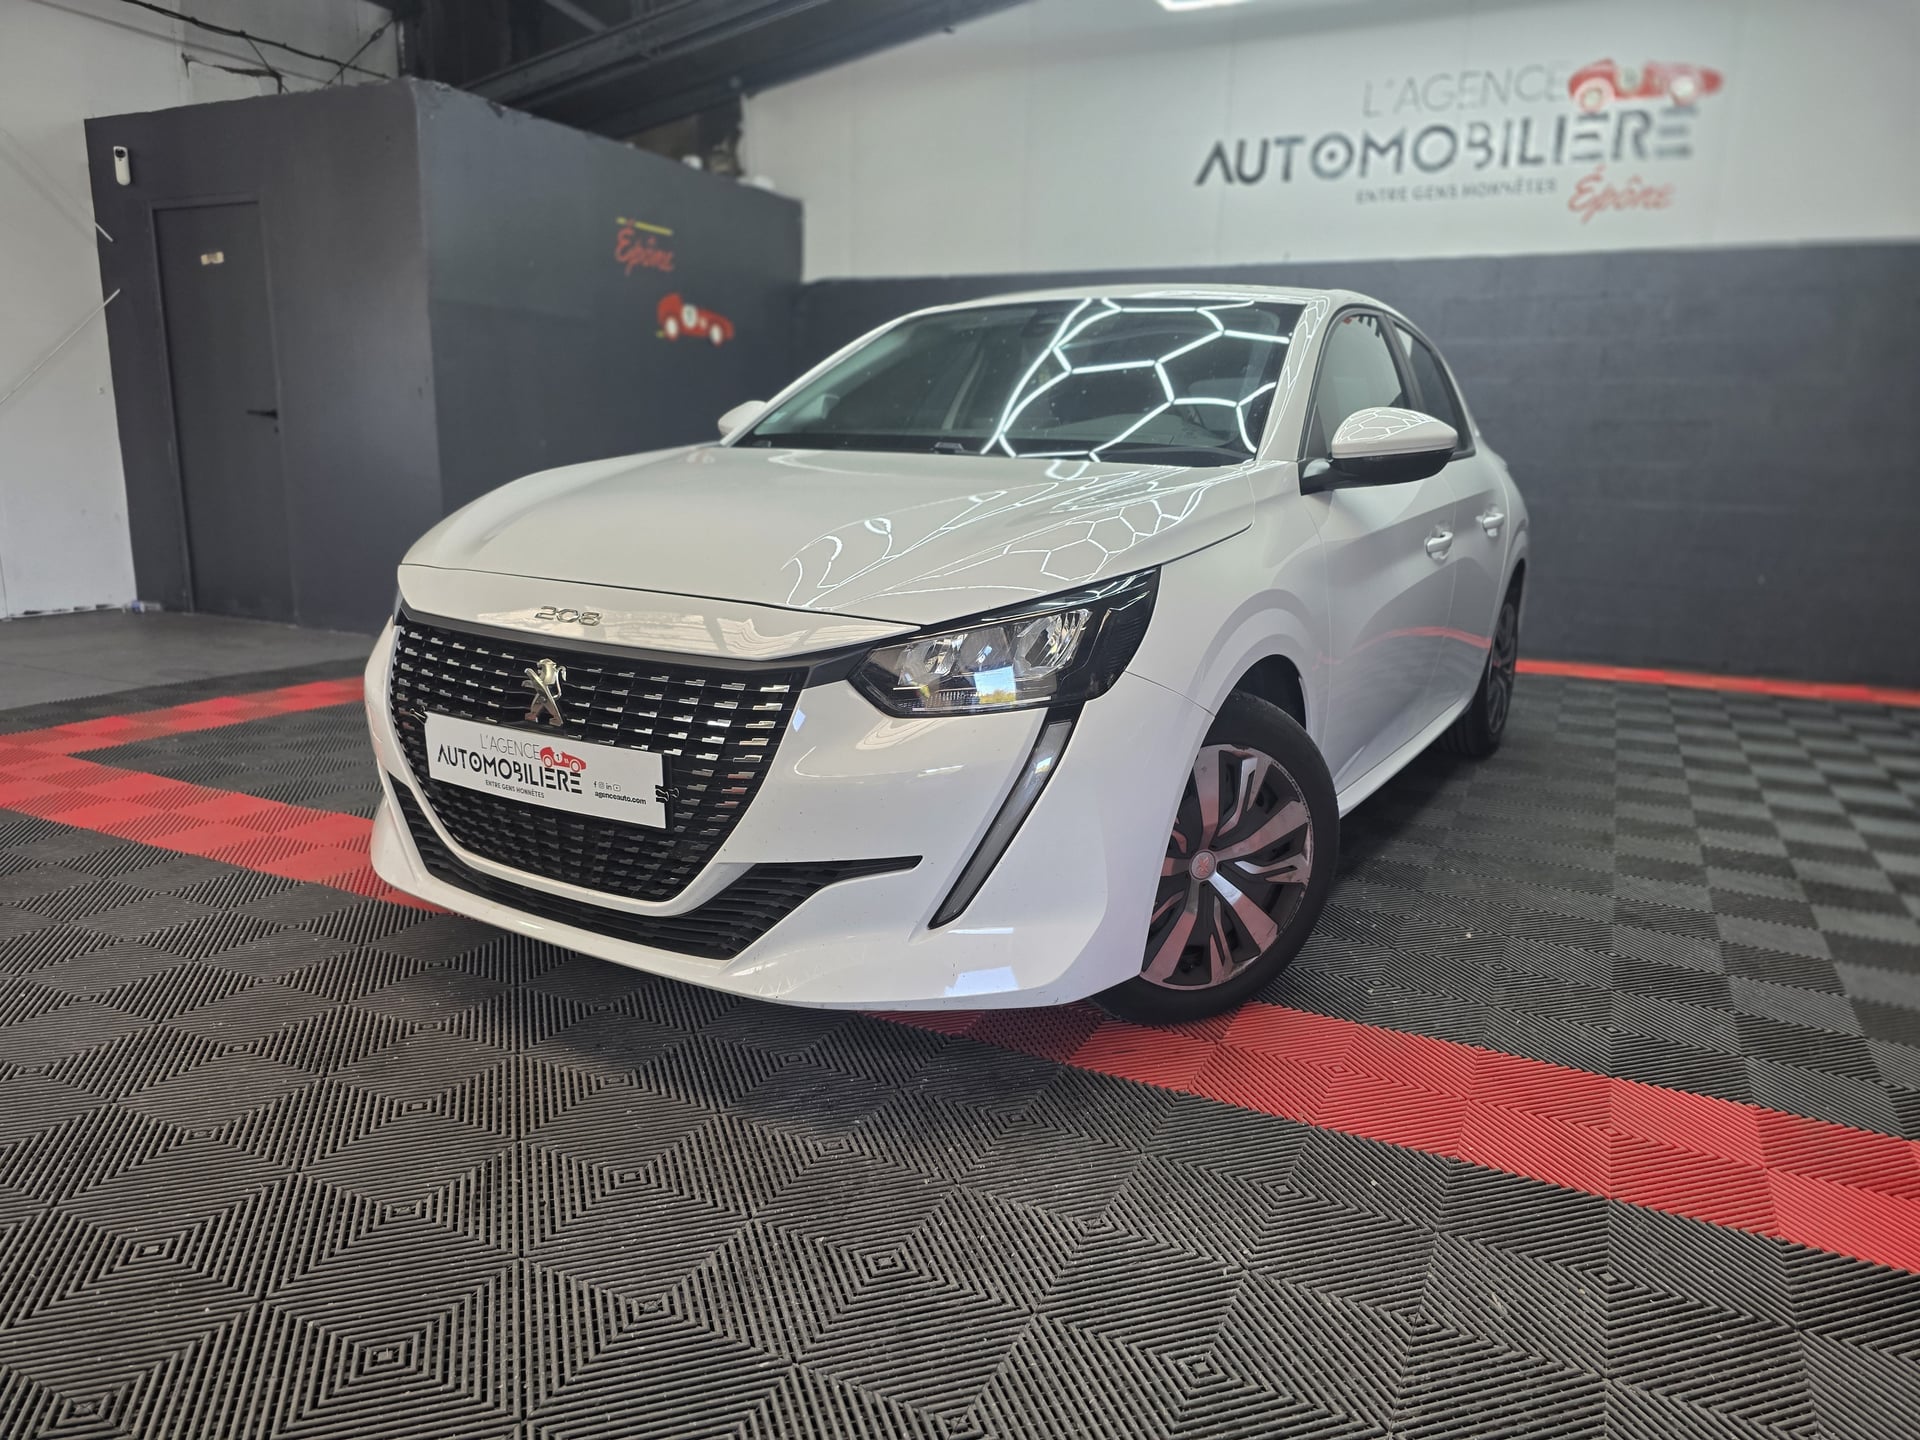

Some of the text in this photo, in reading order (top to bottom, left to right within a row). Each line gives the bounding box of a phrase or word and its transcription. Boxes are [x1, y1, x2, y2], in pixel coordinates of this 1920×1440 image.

[1356, 185, 1408, 204] ENTRE
[1412, 182, 1458, 201] GENS
[534, 605, 602, 626] 208
[479, 733, 541, 761] L'AGENCE
[485, 780, 501, 789] ENTRE
[501, 783, 516, 793] GENS
[594, 791, 647, 805] agenceauto.com
